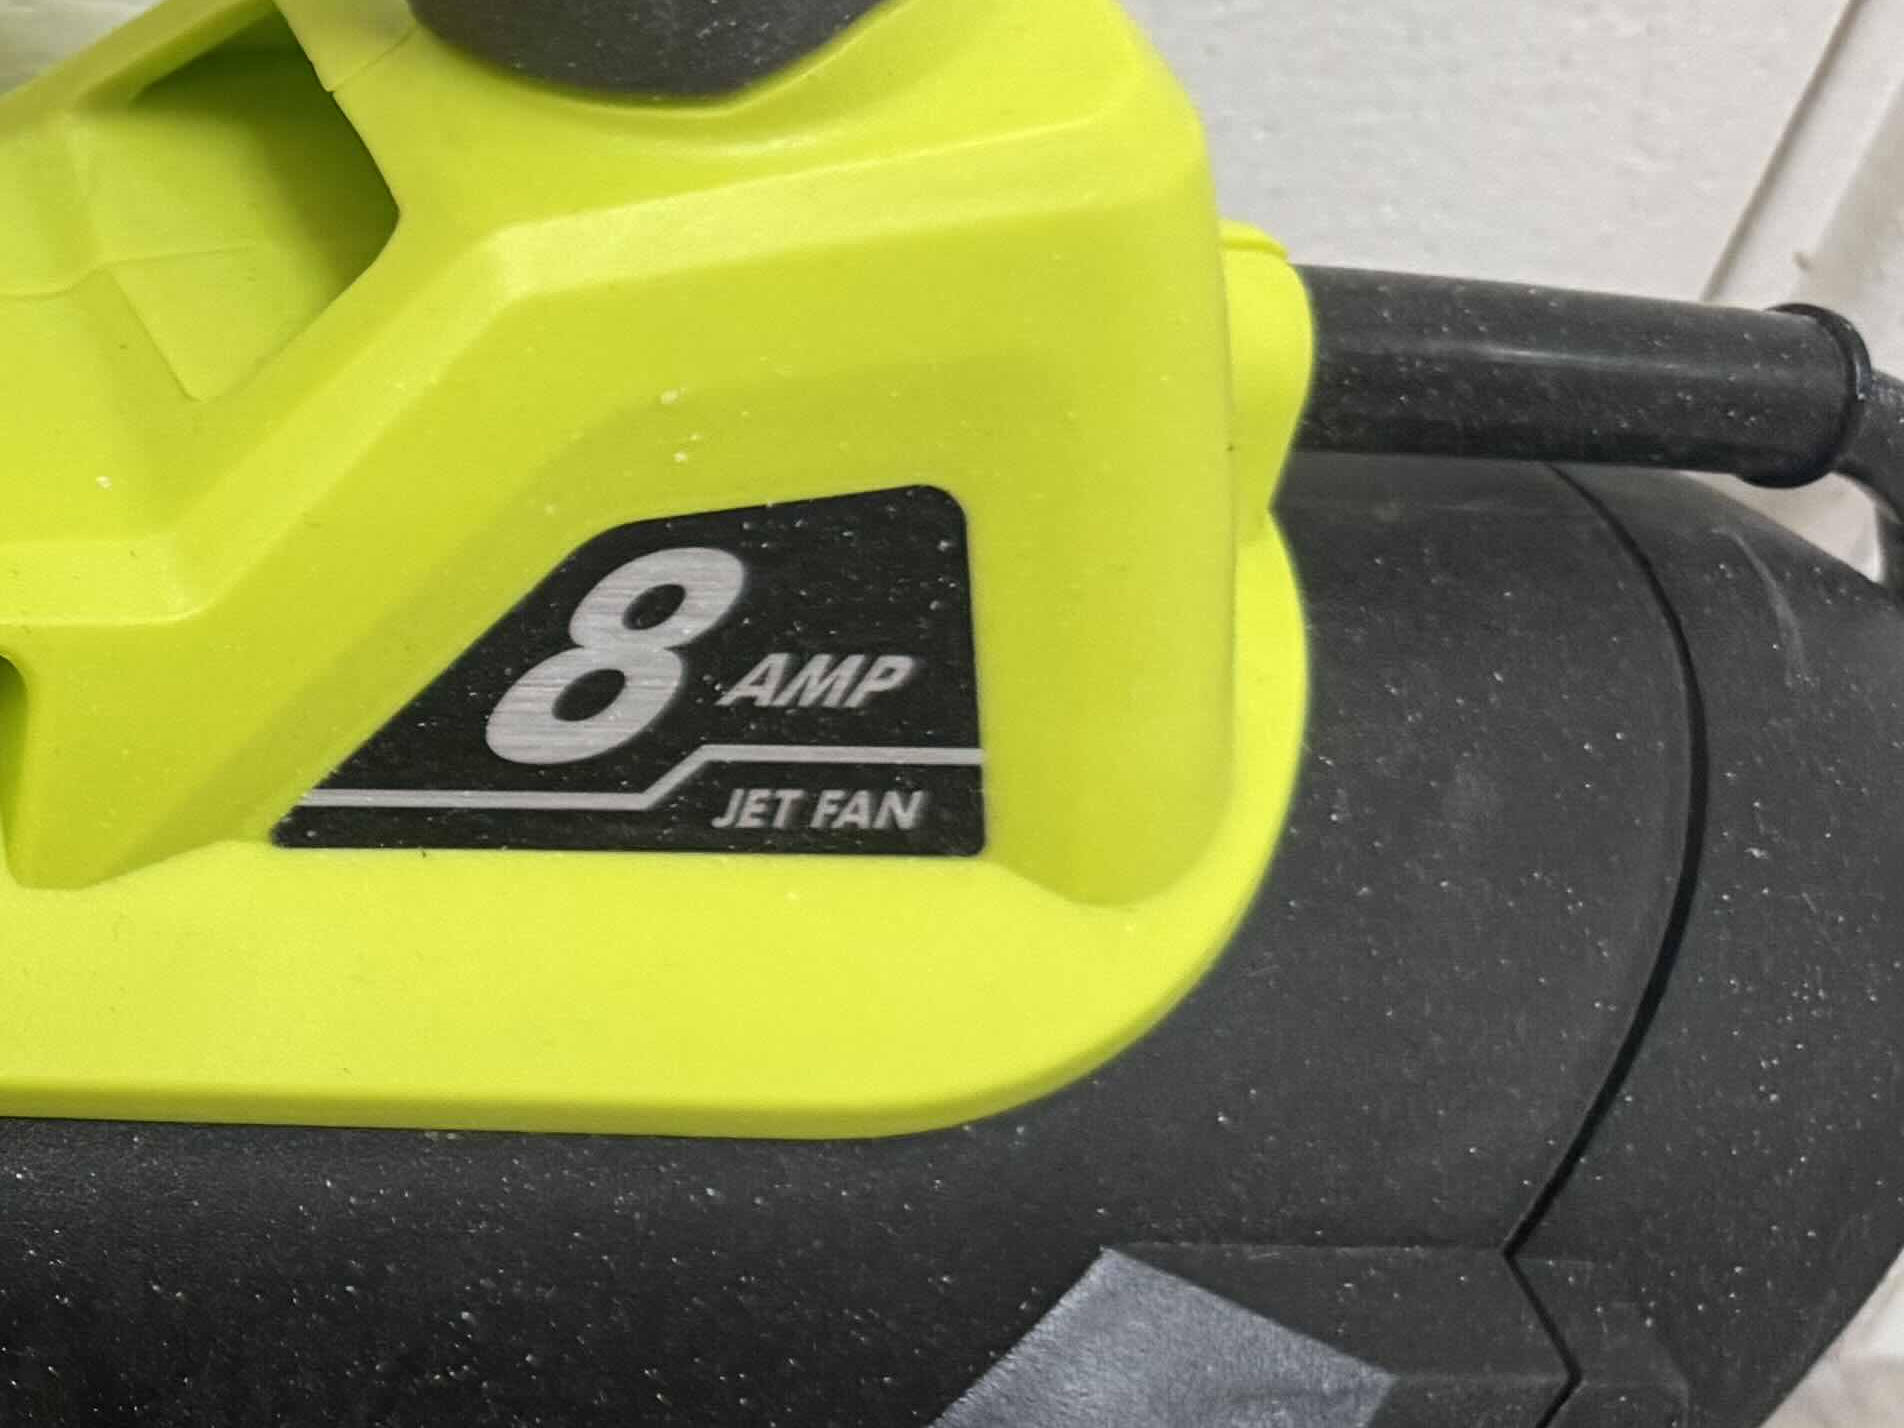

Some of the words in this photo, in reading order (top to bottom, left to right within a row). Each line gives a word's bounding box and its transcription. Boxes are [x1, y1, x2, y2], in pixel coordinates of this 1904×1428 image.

[485, 546, 746, 765] 8
[718, 653, 917, 709] AMP
[712, 789, 806, 829] JET
[811, 790, 924, 831] FAN
